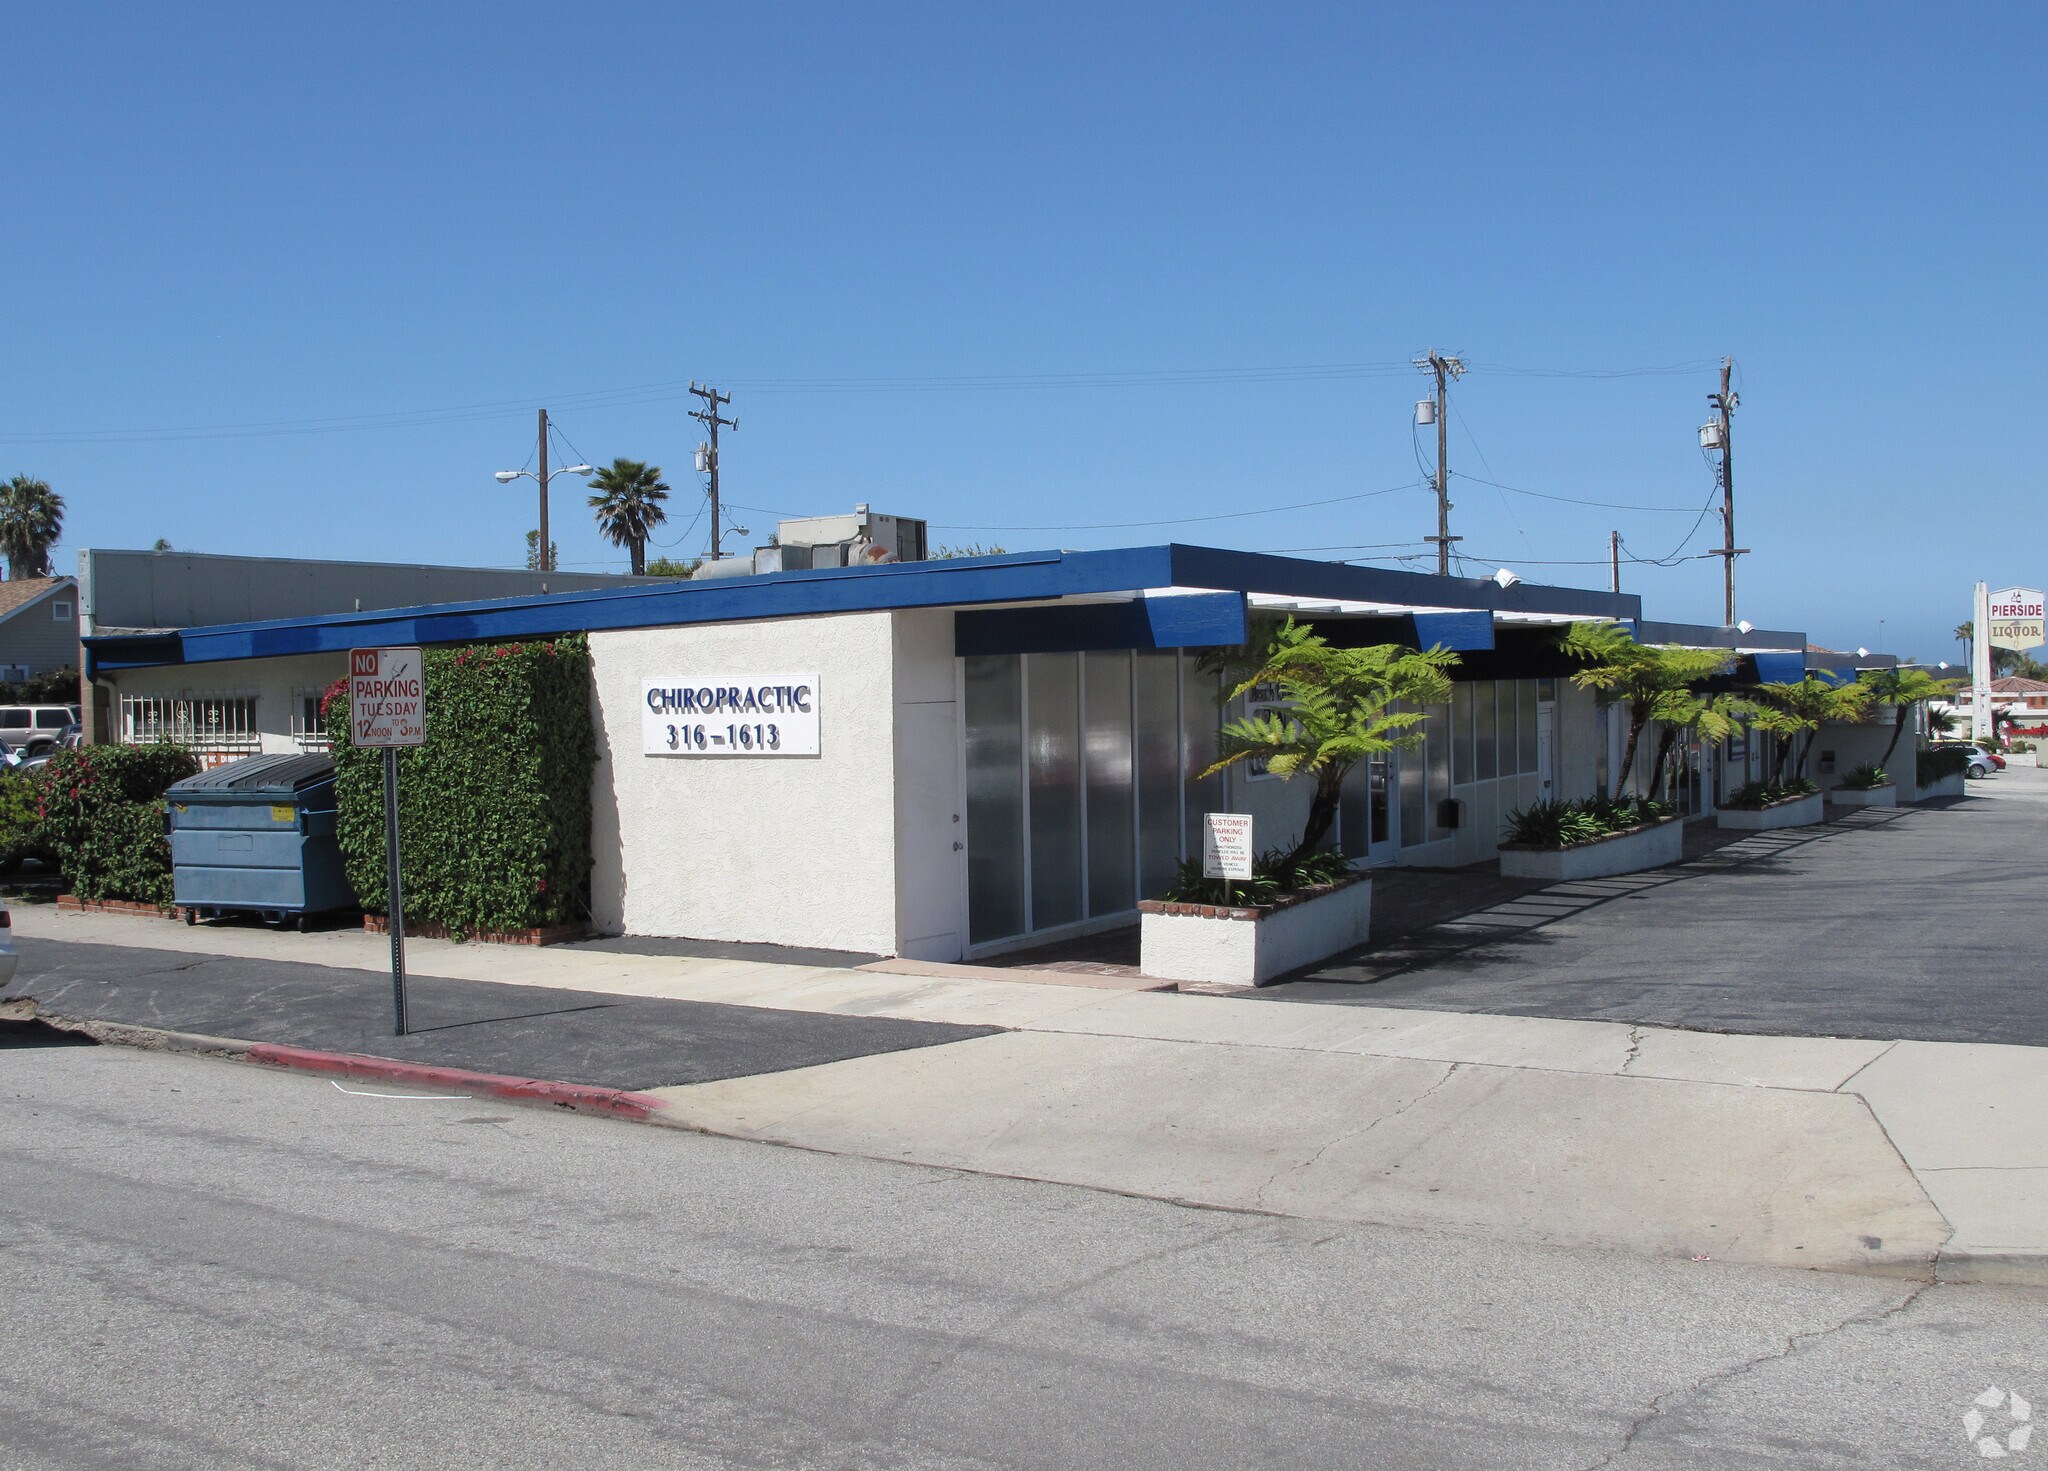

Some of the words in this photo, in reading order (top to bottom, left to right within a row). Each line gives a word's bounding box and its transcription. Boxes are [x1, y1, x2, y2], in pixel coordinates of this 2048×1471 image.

[1992, 604, 2042, 616] PIERSIDE
[1992, 626, 2041, 638] LIQUOR
[355, 654, 375, 673] NO
[356, 679, 420, 699] PARKING
[647, 685, 810, 711] CHIROPRACTIC
[360, 702, 418, 717] TUESDAY
[357, 719, 371, 738] 12
[371, 727, 392, 737] NOON
[392, 718, 400, 727] TO
[400, 718, 409, 737] 3
[1208, 818, 1248, 827] CUSTOMER
[1212, 827, 1243, 835] PARKING
